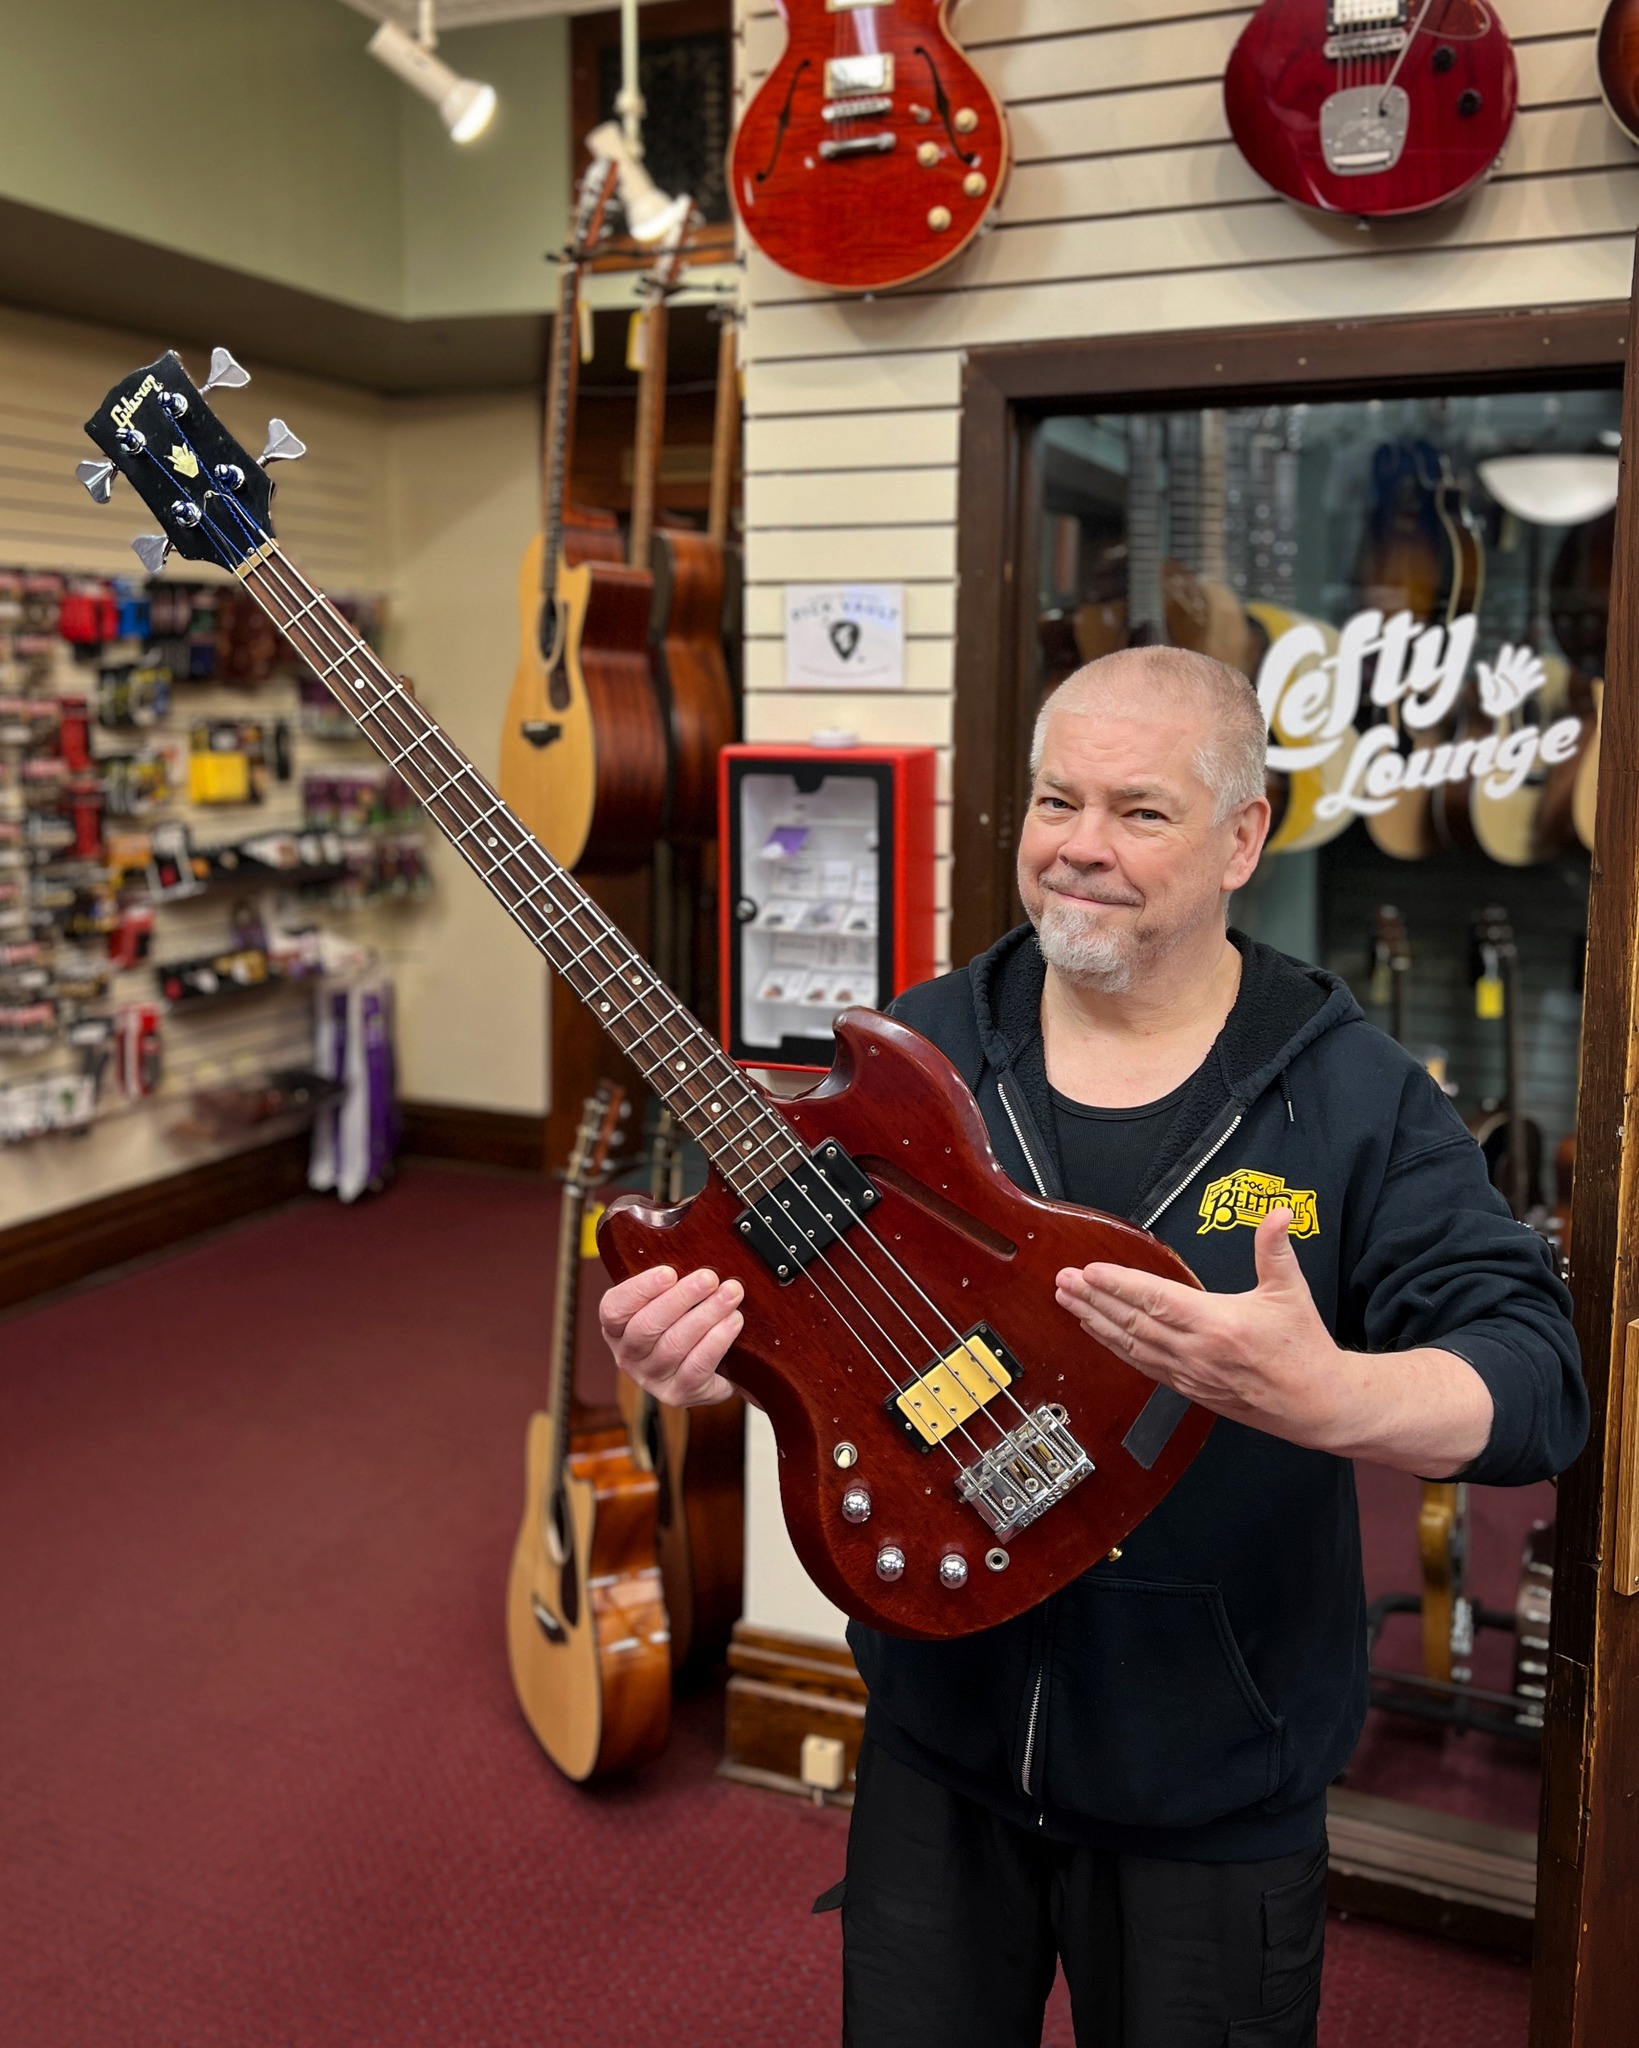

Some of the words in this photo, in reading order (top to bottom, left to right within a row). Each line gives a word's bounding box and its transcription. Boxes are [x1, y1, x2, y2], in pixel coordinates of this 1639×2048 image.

[110, 374, 164, 430] Gibson
[1257, 609, 1478, 771] Lefty
[1314, 716, 1582, 820] Lounge
